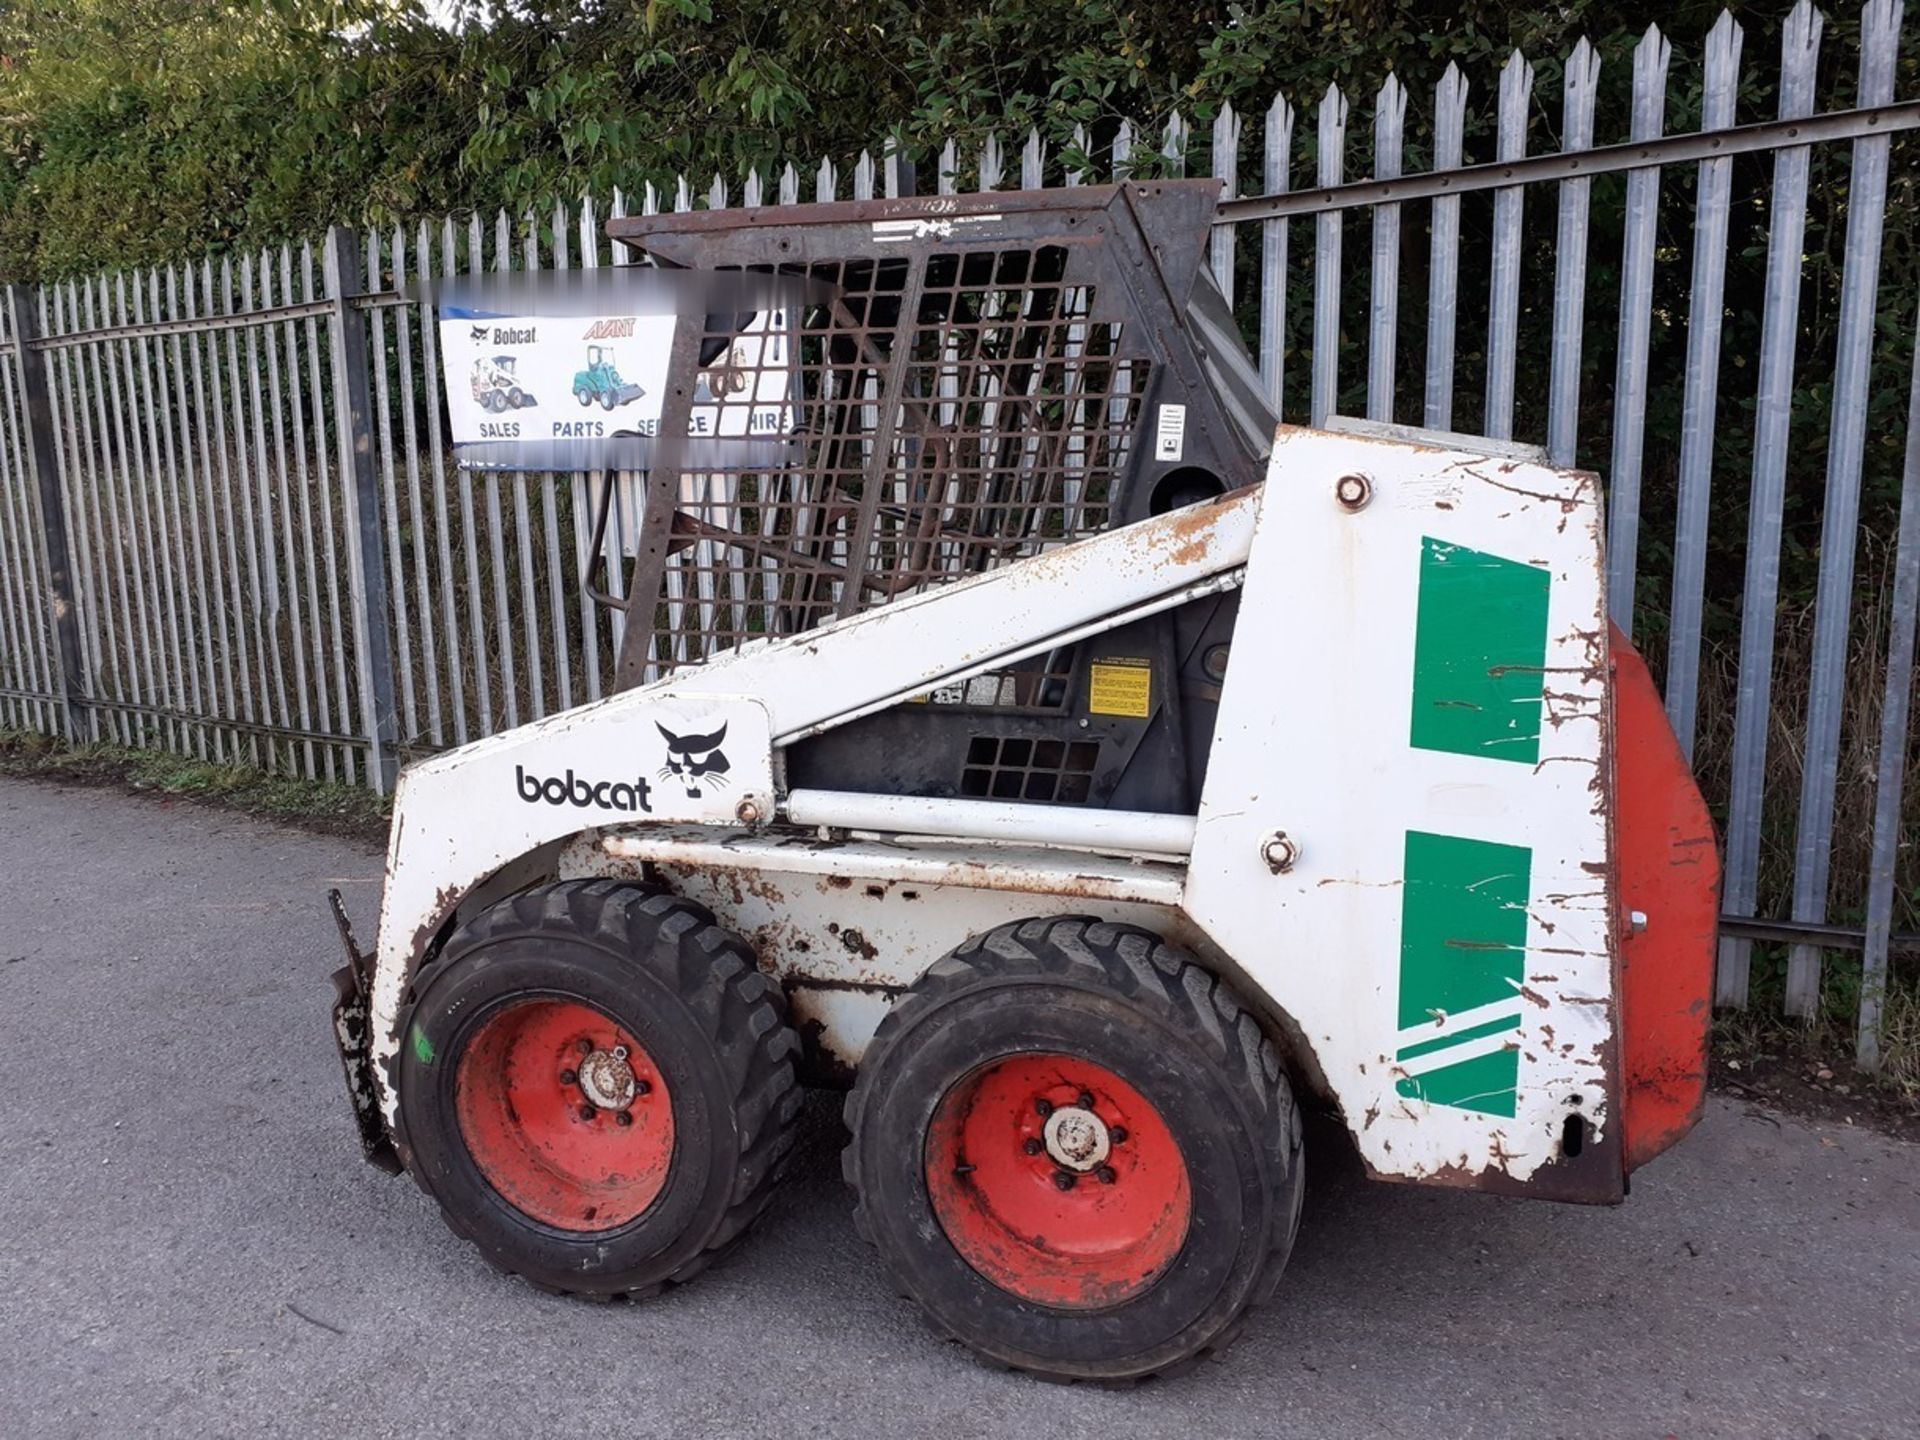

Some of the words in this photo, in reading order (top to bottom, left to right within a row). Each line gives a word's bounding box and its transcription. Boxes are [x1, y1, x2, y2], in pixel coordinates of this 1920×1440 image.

[494, 326, 537, 345] Bobcat
[583, 317, 637, 341] AVANT
[479, 422, 520, 437] SALES
[553, 421, 604, 437] PARTS
[515, 764, 652, 813] bobcat
